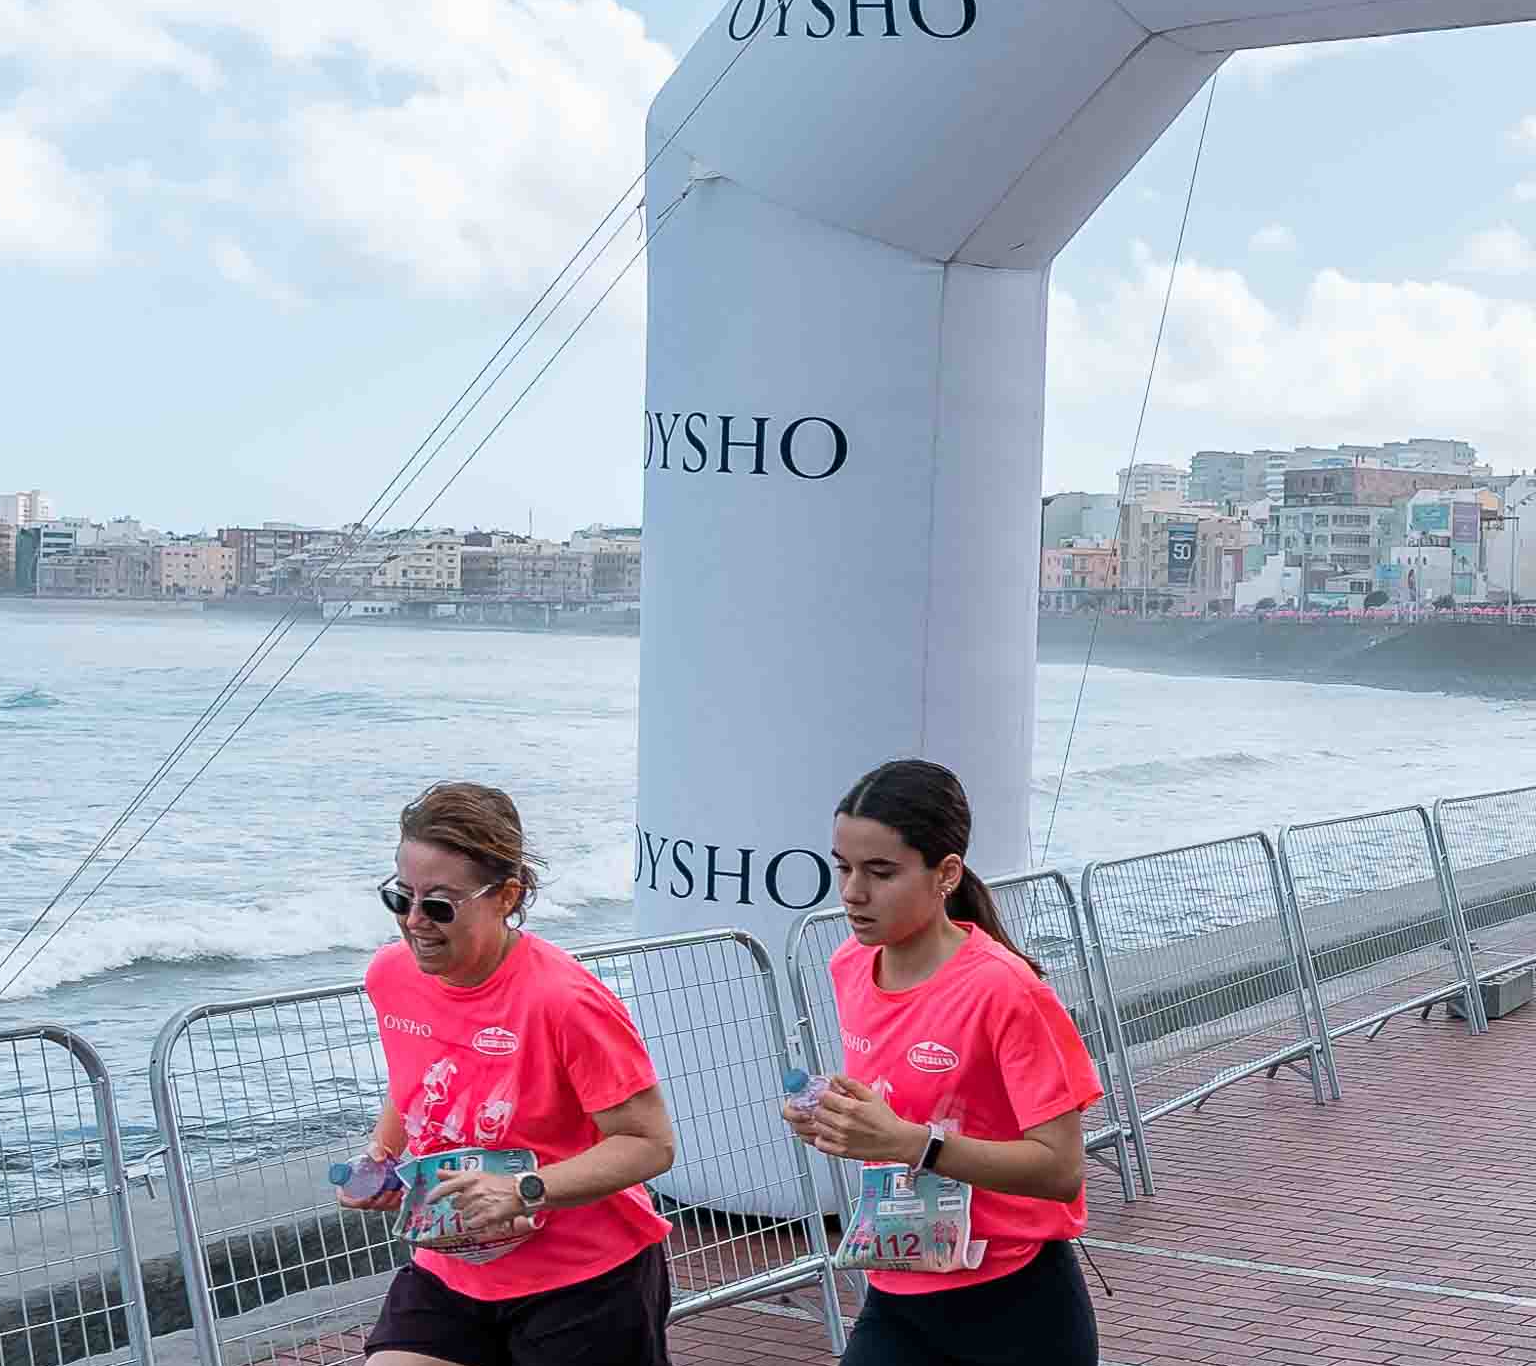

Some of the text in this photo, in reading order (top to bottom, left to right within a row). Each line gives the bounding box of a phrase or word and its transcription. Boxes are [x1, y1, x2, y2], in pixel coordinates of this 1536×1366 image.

[1173, 543, 1192, 560] 50
[383, 1014, 432, 1038] OYSHO
[874, 1233, 921, 1259] 112
